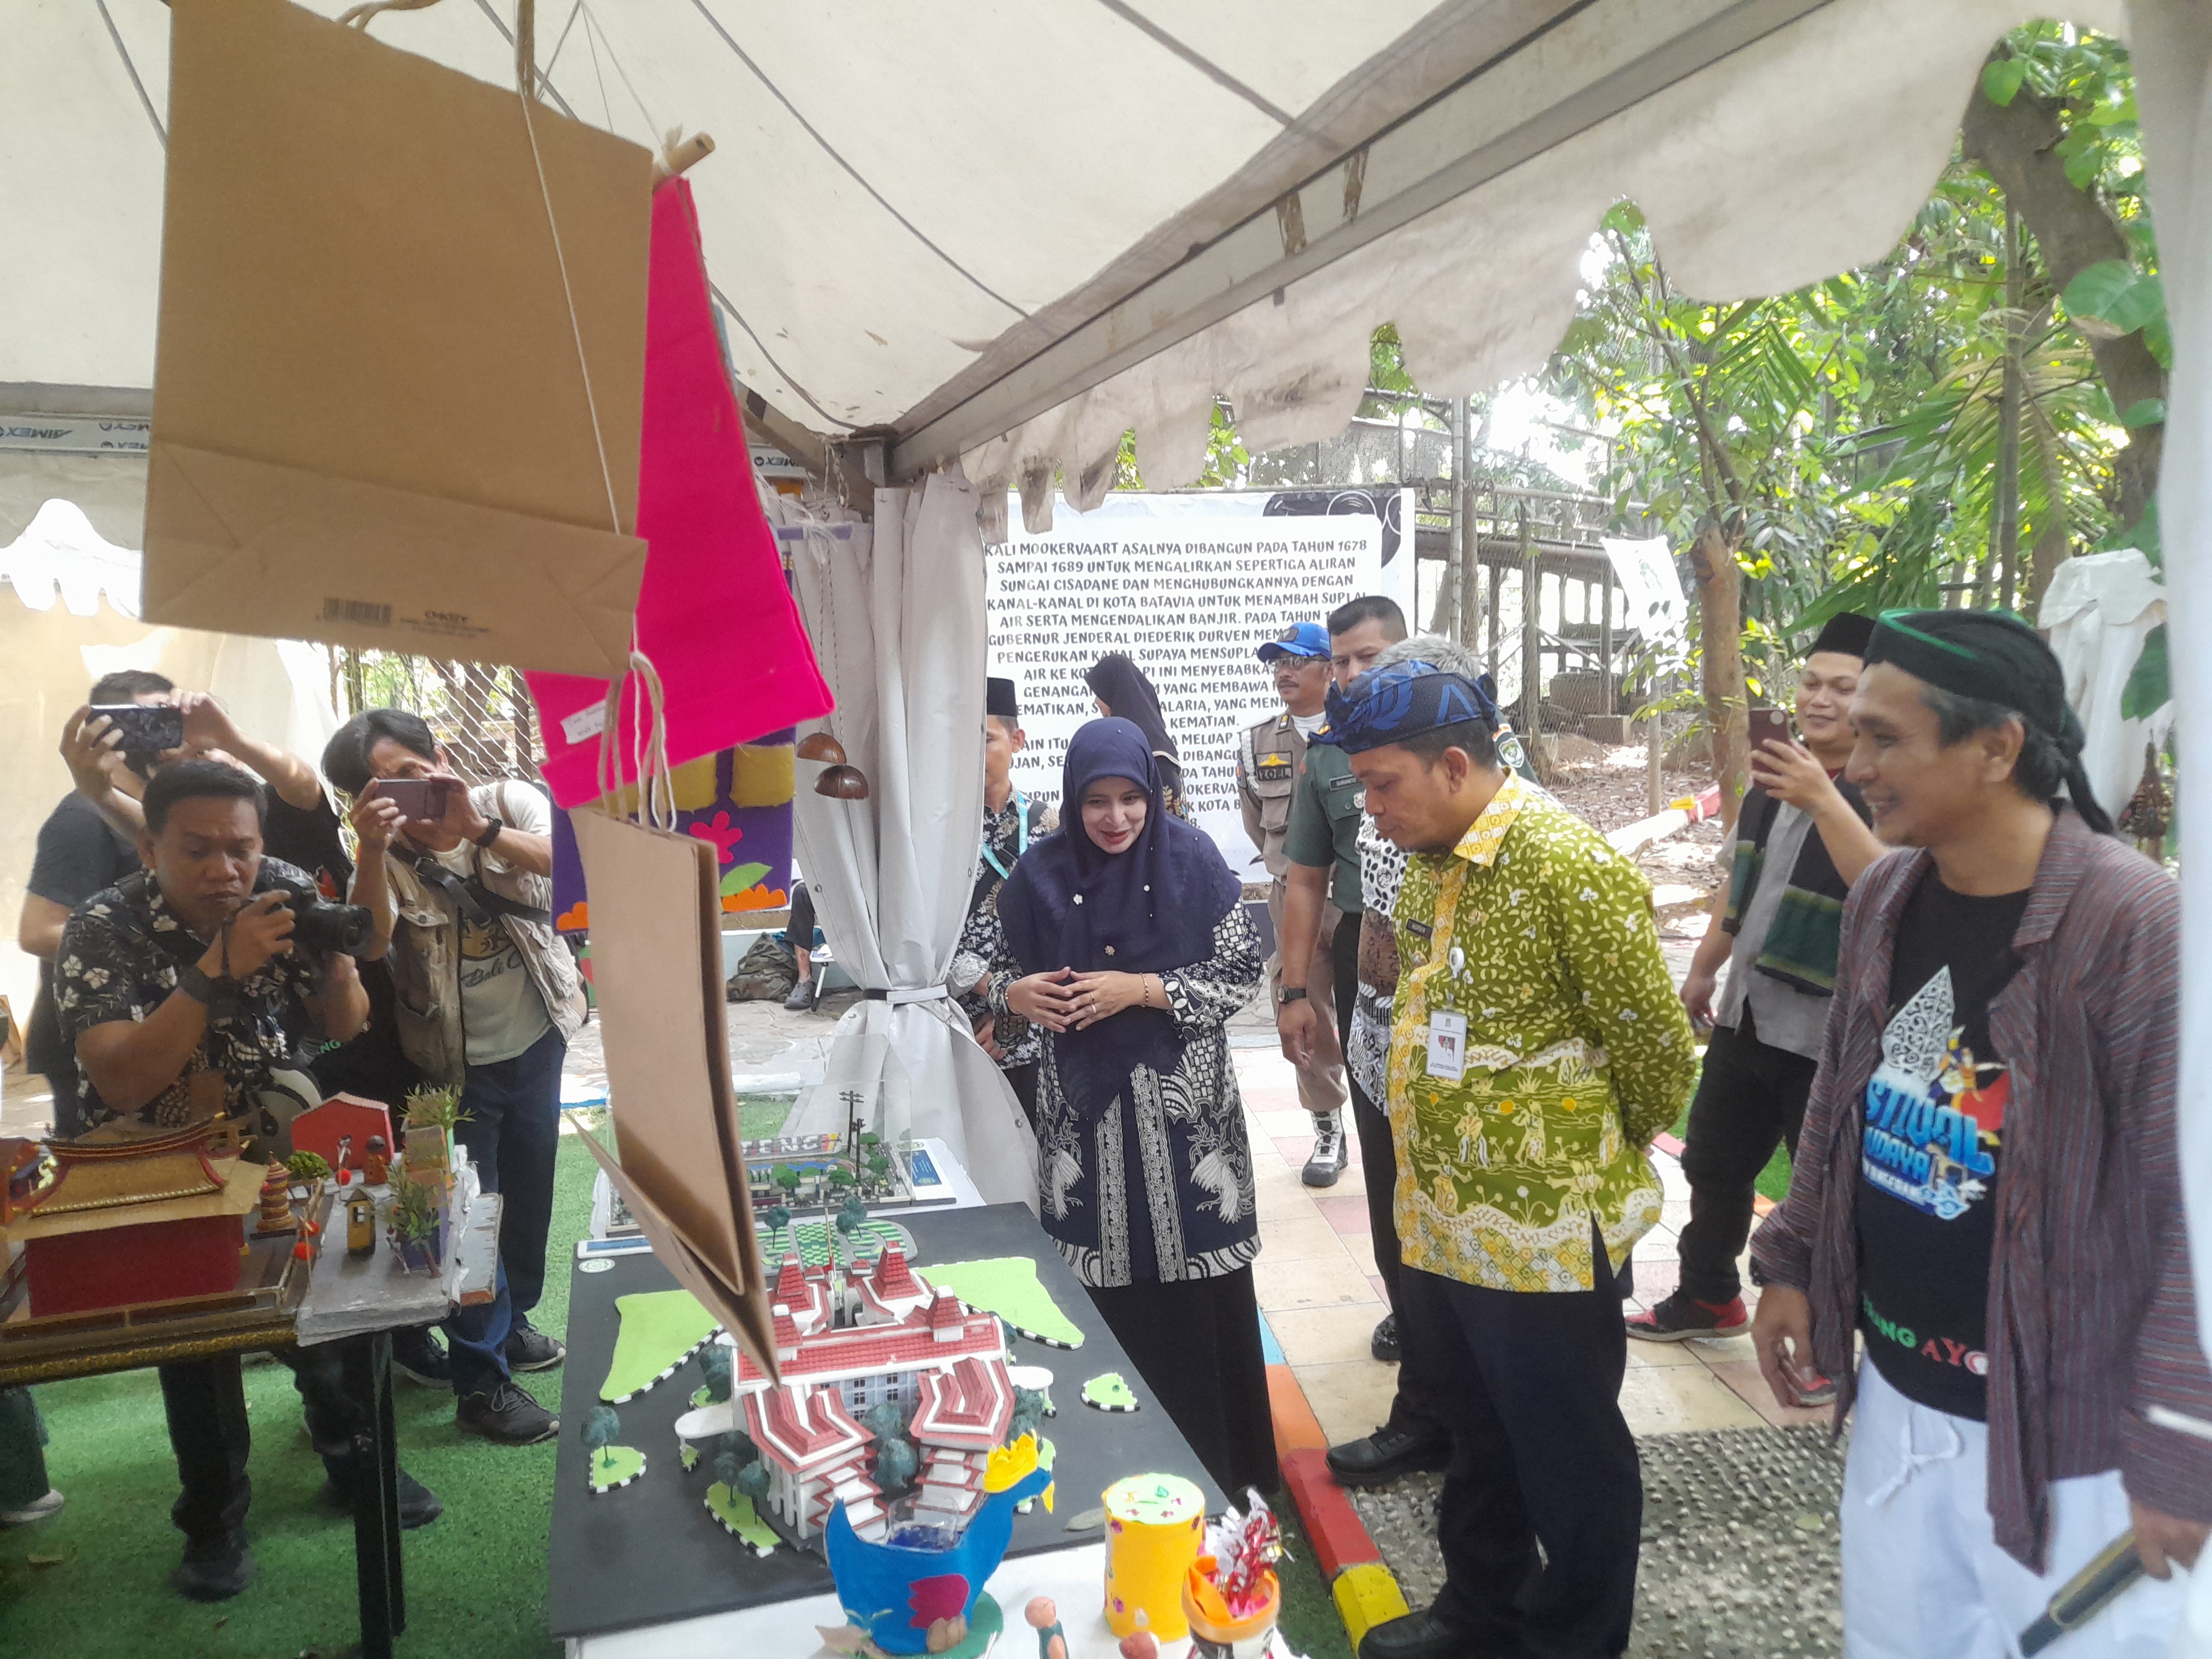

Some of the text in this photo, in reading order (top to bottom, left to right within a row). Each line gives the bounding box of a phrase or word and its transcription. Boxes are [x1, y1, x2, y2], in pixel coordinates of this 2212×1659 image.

[984, 540, 1367, 557] KALI MOOKERVAART ASALNYA DIBANGUN PADA TAHUN 1678
[997, 557, 1355, 575] SAMPAI 1689 UNTUK MENGALIRKAN SEPERTIGA ALIRAN
[1000, 575, 1353, 592] SUNGAI CISADANE DAN MENGHUBUNGKANNYA DENGAN
[987, 597, 1084, 611] KANAL-KANAL
[1086, 597, 1099, 608] DI
[1103, 596, 1136, 609] KOTA
[1140, 596, 1195, 608] BATAVIA
[1198, 594, 1241, 607] UNTUK
[1245, 593, 1318, 606] MENAMBAH
[1000, 616, 1022, 628] AIR
[1026, 614, 1068, 627] SERTA
[1071, 613, 1185, 626] MENGENDALIKAN
[1190, 612, 1241, 625] BANJIR.
[1245, 612, 1277, 624] PADA
[1280, 610, 1321, 624] TAHUN
[987, 632, 1060, 646] GUBERNUR
[1063, 632, 1131, 644] JENDERAL
[1134, 630, 1195, 643] DIEDERIK
[1198, 629, 1250, 642] DURVEN
[997, 650, 1088, 664] PENGERUKAN
[1138, 649, 1187, 661] SUPAYA
[1190, 646, 1258, 659] MENSUPLA
[1024, 668, 1046, 681] AIR
[1050, 668, 1067, 680] KE
[1159, 665, 1177, 677] INI
[1181, 663, 1274, 677] MENYEBABKA
[1163, 682, 1197, 695] YANG
[1201, 681, 1269, 693] MEMBAWA
[1017, 702, 1088, 717] EMATIKAN,
[1160, 700, 1211, 713] ALARIA,
[1214, 698, 1247, 711] YANG
[1170, 715, 1239, 729] KEMATIAN.
[1181, 732, 1233, 745] MELUAP
[1183, 749, 1239, 761] DIBANGU
[1201, 765, 1237, 778] TAHU
[1198, 799, 1230, 812] KOTA
